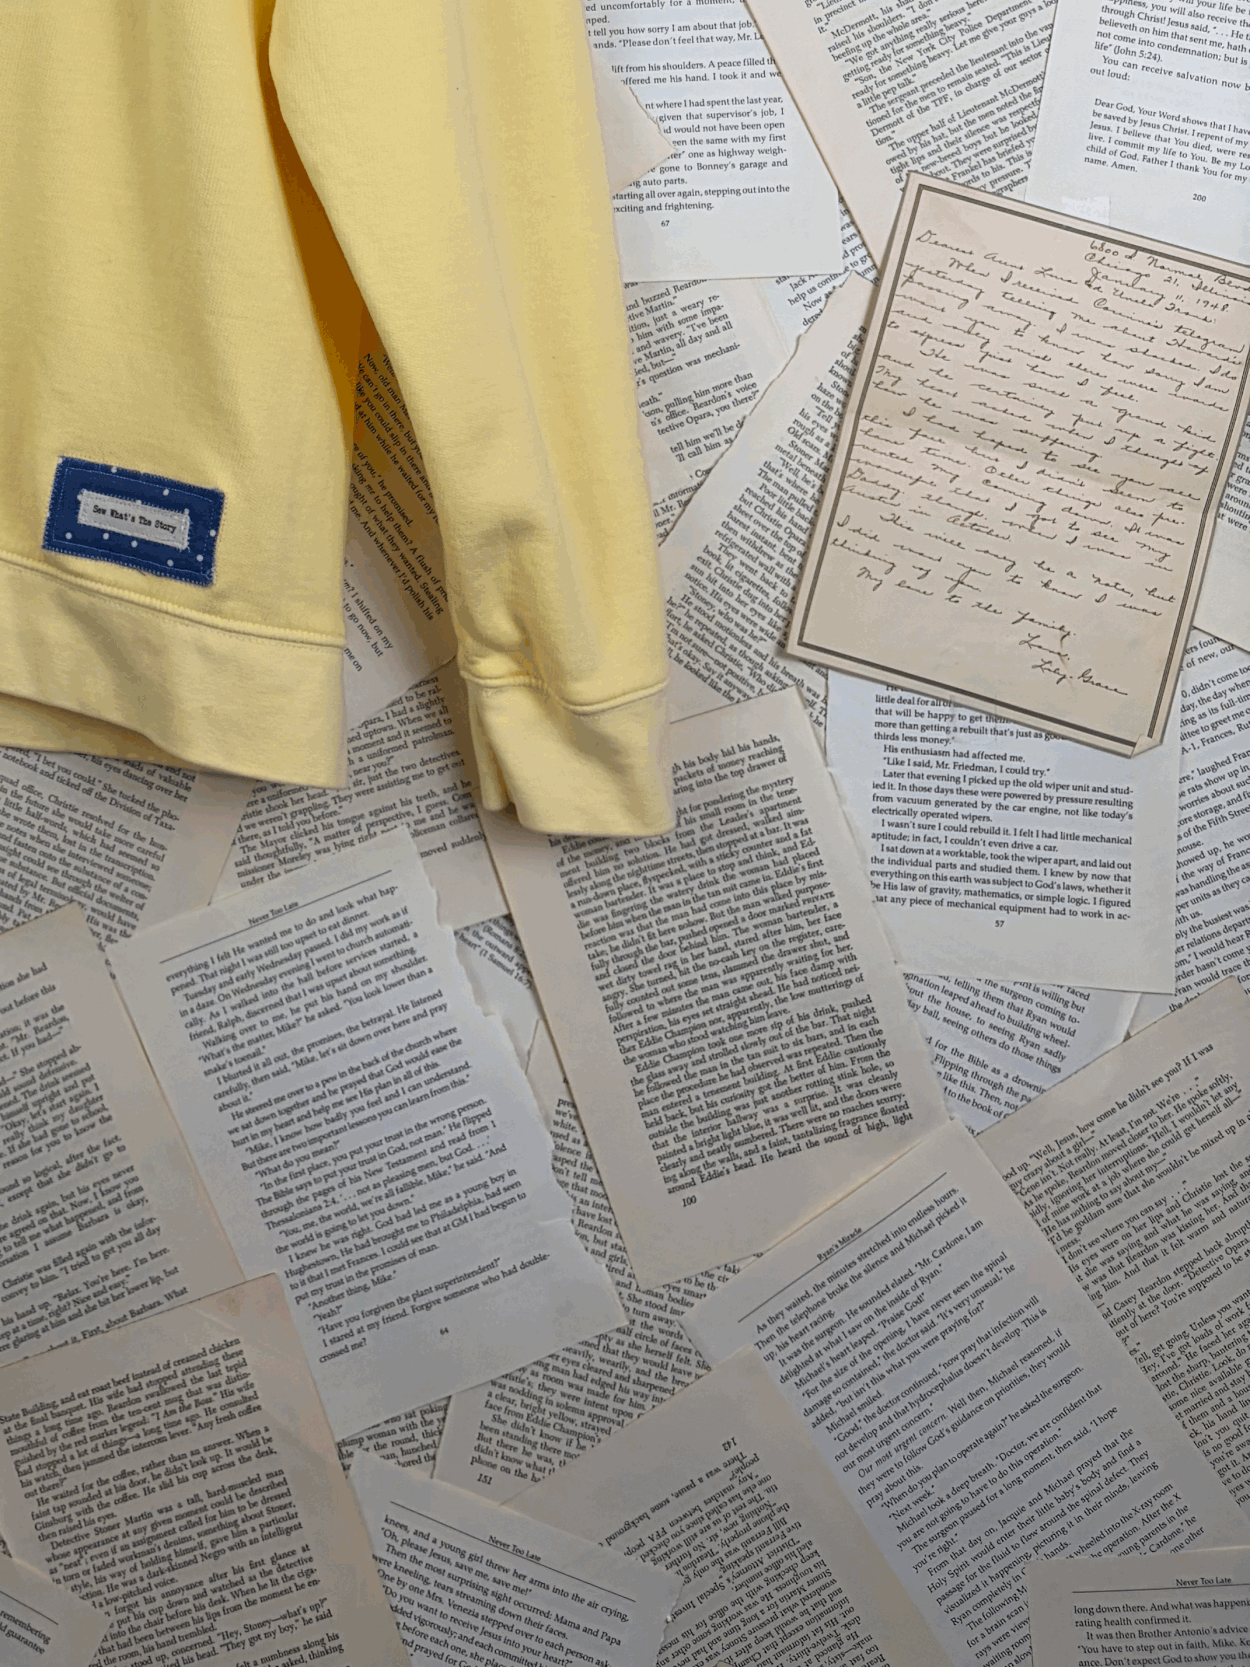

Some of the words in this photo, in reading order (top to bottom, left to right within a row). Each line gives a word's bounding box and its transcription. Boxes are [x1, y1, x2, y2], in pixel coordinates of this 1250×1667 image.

[659, 165, 681, 175] gone
[683, 164, 693, 172] to
[696, 161, 736, 172] Bonney's
[739, 161, 768, 172] garage
[771, 158, 788, 167] and
[1083, 156, 1107, 167] name.
[1110, 160, 1138, 173] Amen.
[1193, 194, 1206, 202] 200
[661, 219, 670, 228] 67
[93, 505, 106, 516] Sew
[110, 510, 136, 523] What's
[138, 516, 152, 527] The
[154, 519, 177, 534] Story
[883, 744, 899, 754] His
[900, 746, 951, 758] enthusiasm
[952, 748, 970, 759] had
[971, 750, 1008, 762] affected
[1009, 755, 1026, 763] me.
[871, 805, 919, 820] electrically
[920, 810, 959, 821] operated
[961, 812, 993, 824] wipers.
[995, 920, 1004, 928] 57
[682, 1195, 697, 1207] 100
[476, 1473, 493, 1485] 151
[485, 1534, 511, 1550] Never
[512, 1544, 525, 1556] Too
[525, 1550, 542, 1562] Late
[1175, 1578, 1199, 1587] Never
[1200, 1577, 1215, 1585] Too
[1215, 1576, 1232, 1585] Late
[1074, 1618, 1103, 1630] rating
[1103, 1616, 1133, 1627] health
[1133, 1614, 1181, 1626] confirmed
[1182, 1615, 1192, 1623] it.
